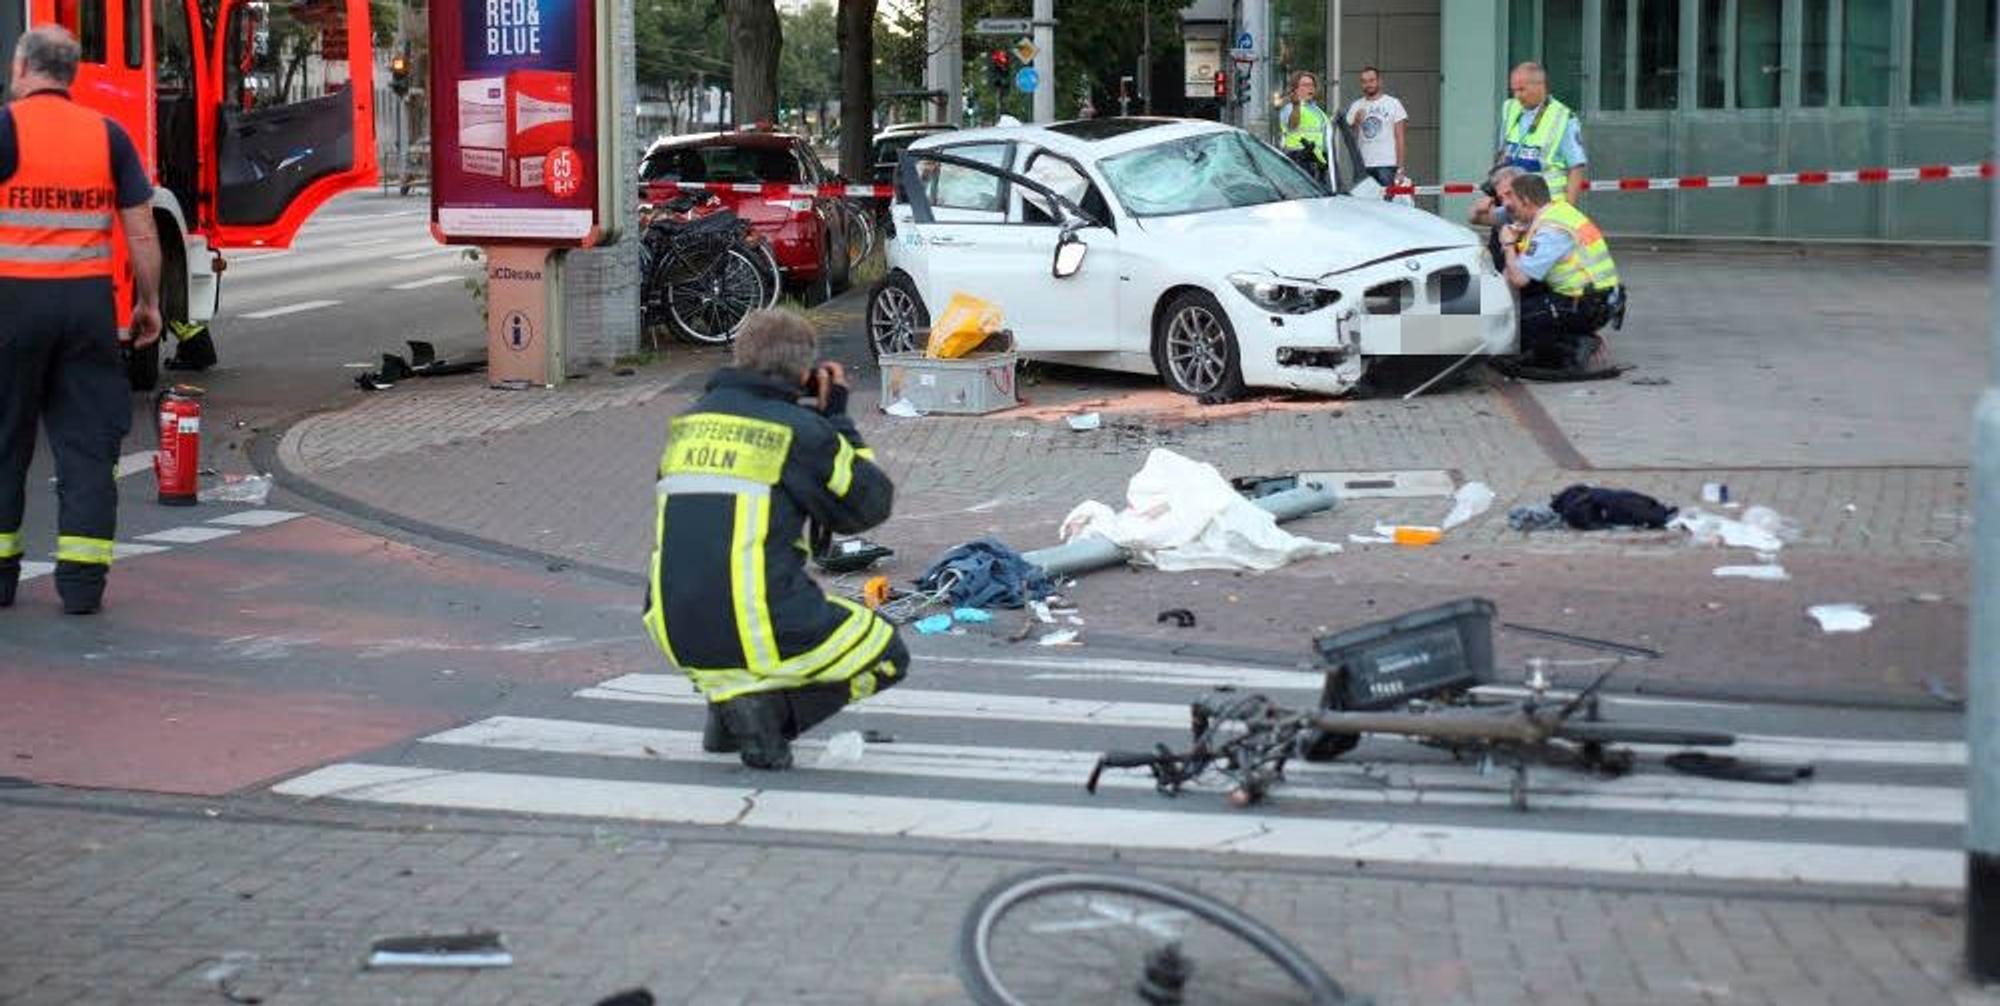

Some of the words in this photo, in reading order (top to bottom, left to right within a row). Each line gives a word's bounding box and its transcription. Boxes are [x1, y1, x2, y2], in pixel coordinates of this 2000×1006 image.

[486, 0, 540, 26] RED&
[487, 26, 541, 55] BLUE
[684, 442, 737, 469] KÖLN
